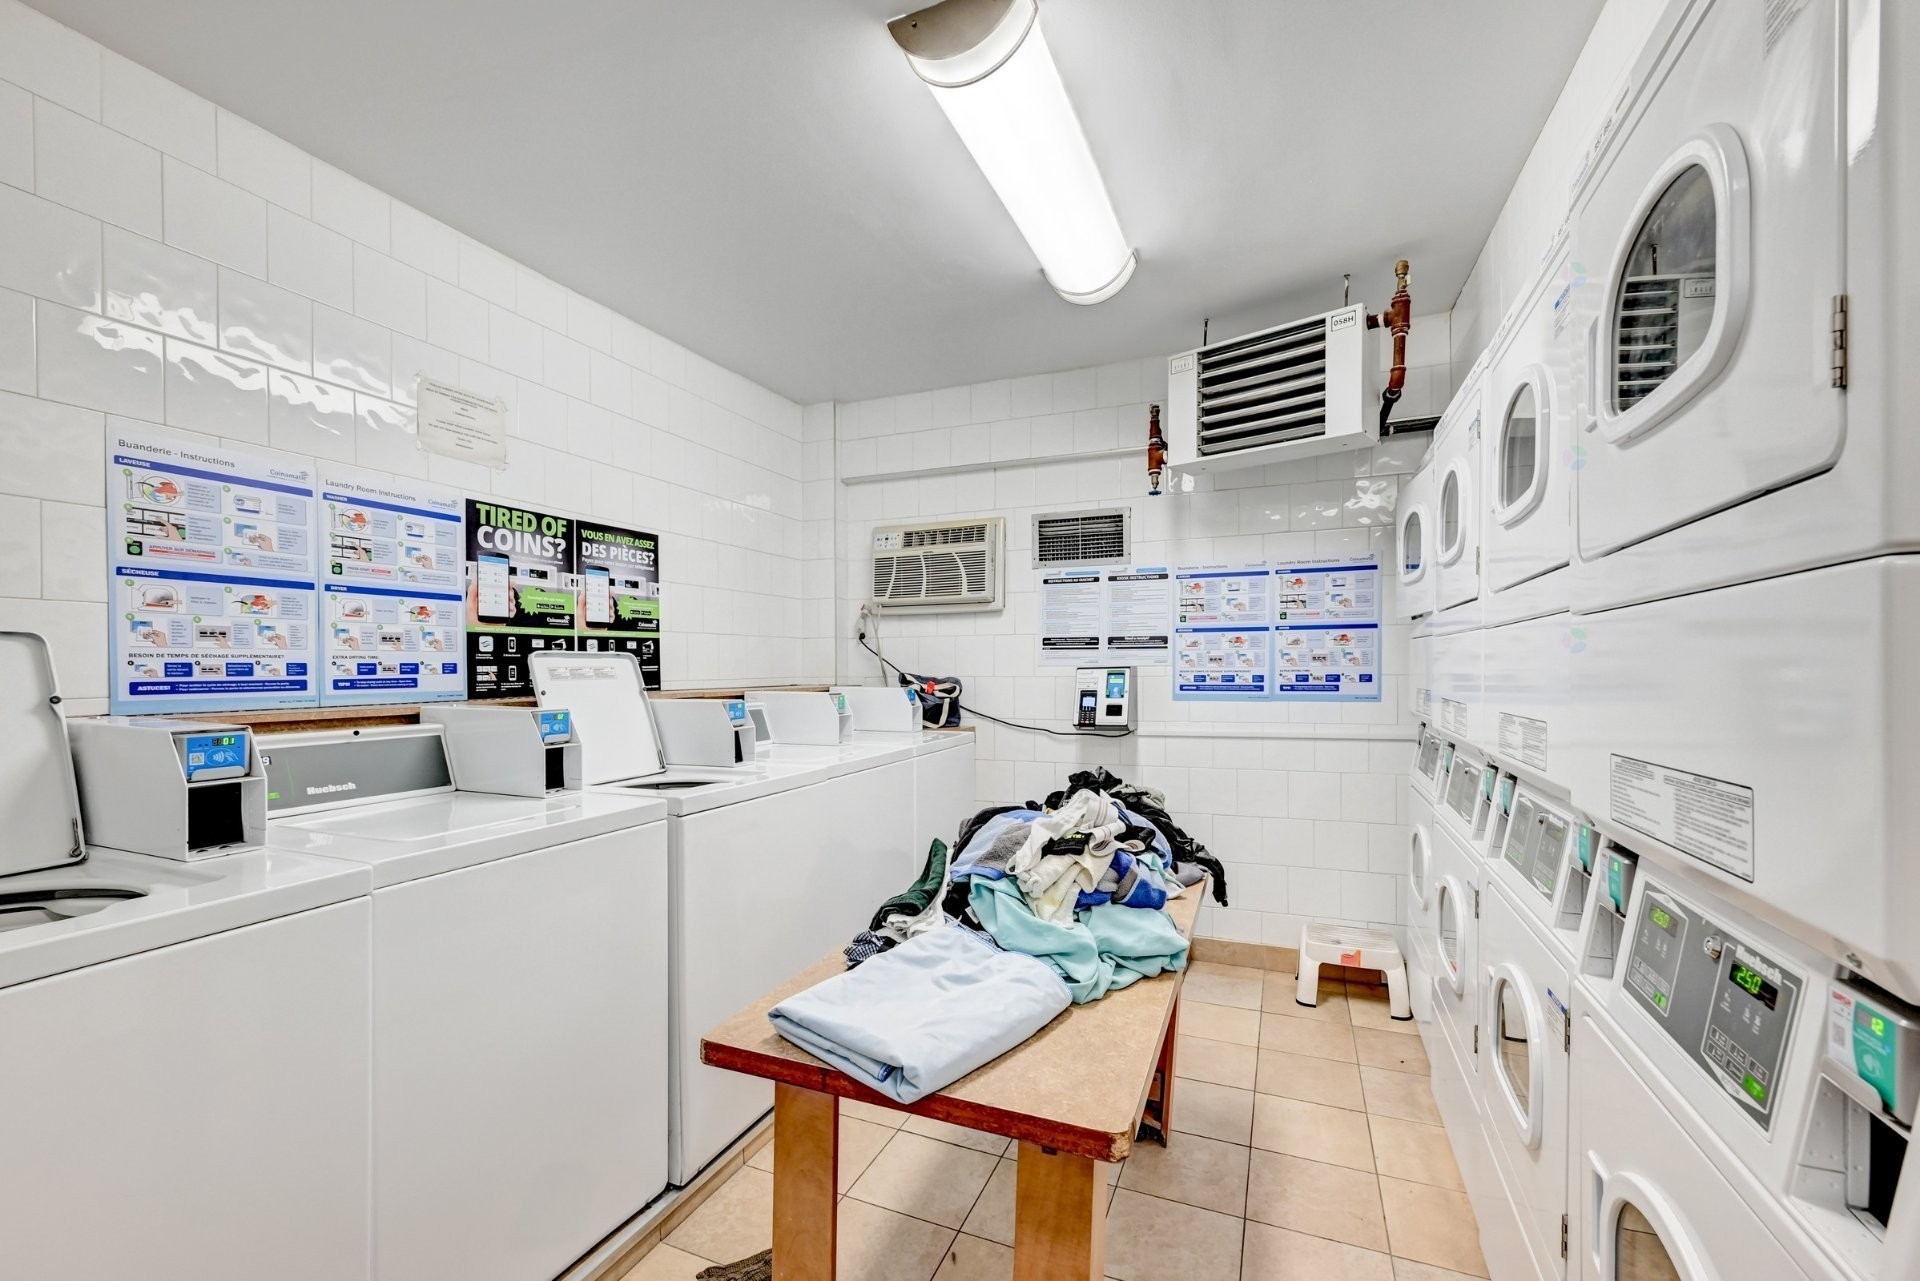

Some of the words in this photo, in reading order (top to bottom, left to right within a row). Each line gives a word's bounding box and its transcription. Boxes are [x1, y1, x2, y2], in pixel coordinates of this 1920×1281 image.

[118, 438, 172, 456] Buanderie
[180, 450, 235, 468] Instructions
[118, 457, 150, 467] LAVEUSE
[269, 468, 309, 482] Coinamatic
[325, 479, 354, 491] Laundry
[356, 485, 377, 494] Room
[378, 488, 416, 502] Instructions
[476, 502, 537, 533] TIRED
[541, 516, 567, 538] OF
[477, 525, 566, 560] COINS?
[581, 528, 604, 541] VOUS
[605, 533, 615, 542] EN
[616, 535, 634, 546] AVEZ
[634, 538, 655, 550] ASSEZ
[582, 541, 607, 558] DES
[610, 544, 655, 565] PIÈCES?
[121, 568, 160, 577] SÉCHEUSE
[306, 782, 356, 795] Huebsch
[1737, 966, 1762, 994] 250
